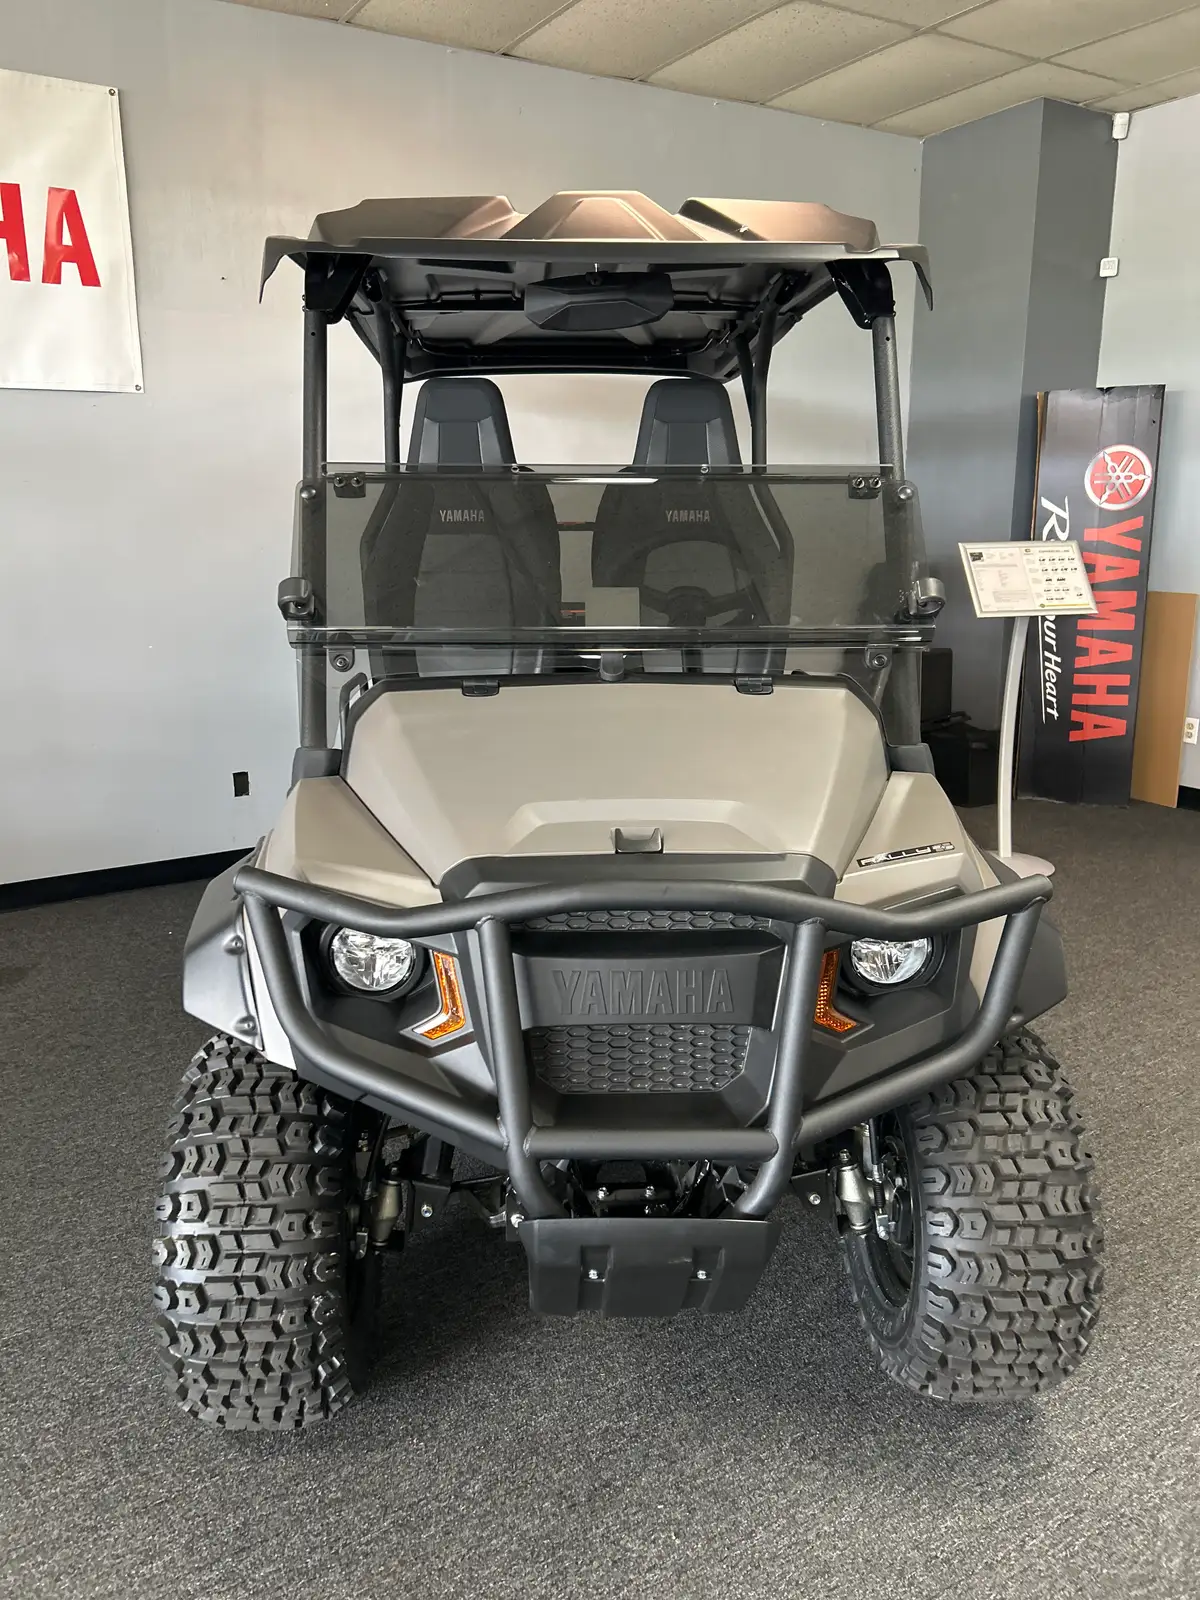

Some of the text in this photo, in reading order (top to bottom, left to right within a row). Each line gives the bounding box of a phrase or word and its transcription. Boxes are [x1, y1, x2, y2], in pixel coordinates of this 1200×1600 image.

[439, 509, 485, 523] YAMAHA
[665, 509, 711, 523] YAMAHA
[1069, 516, 1144, 742] YAMAHA
[1044, 650, 1062, 720] Heart
[551, 969, 735, 1016] YAMAHA
